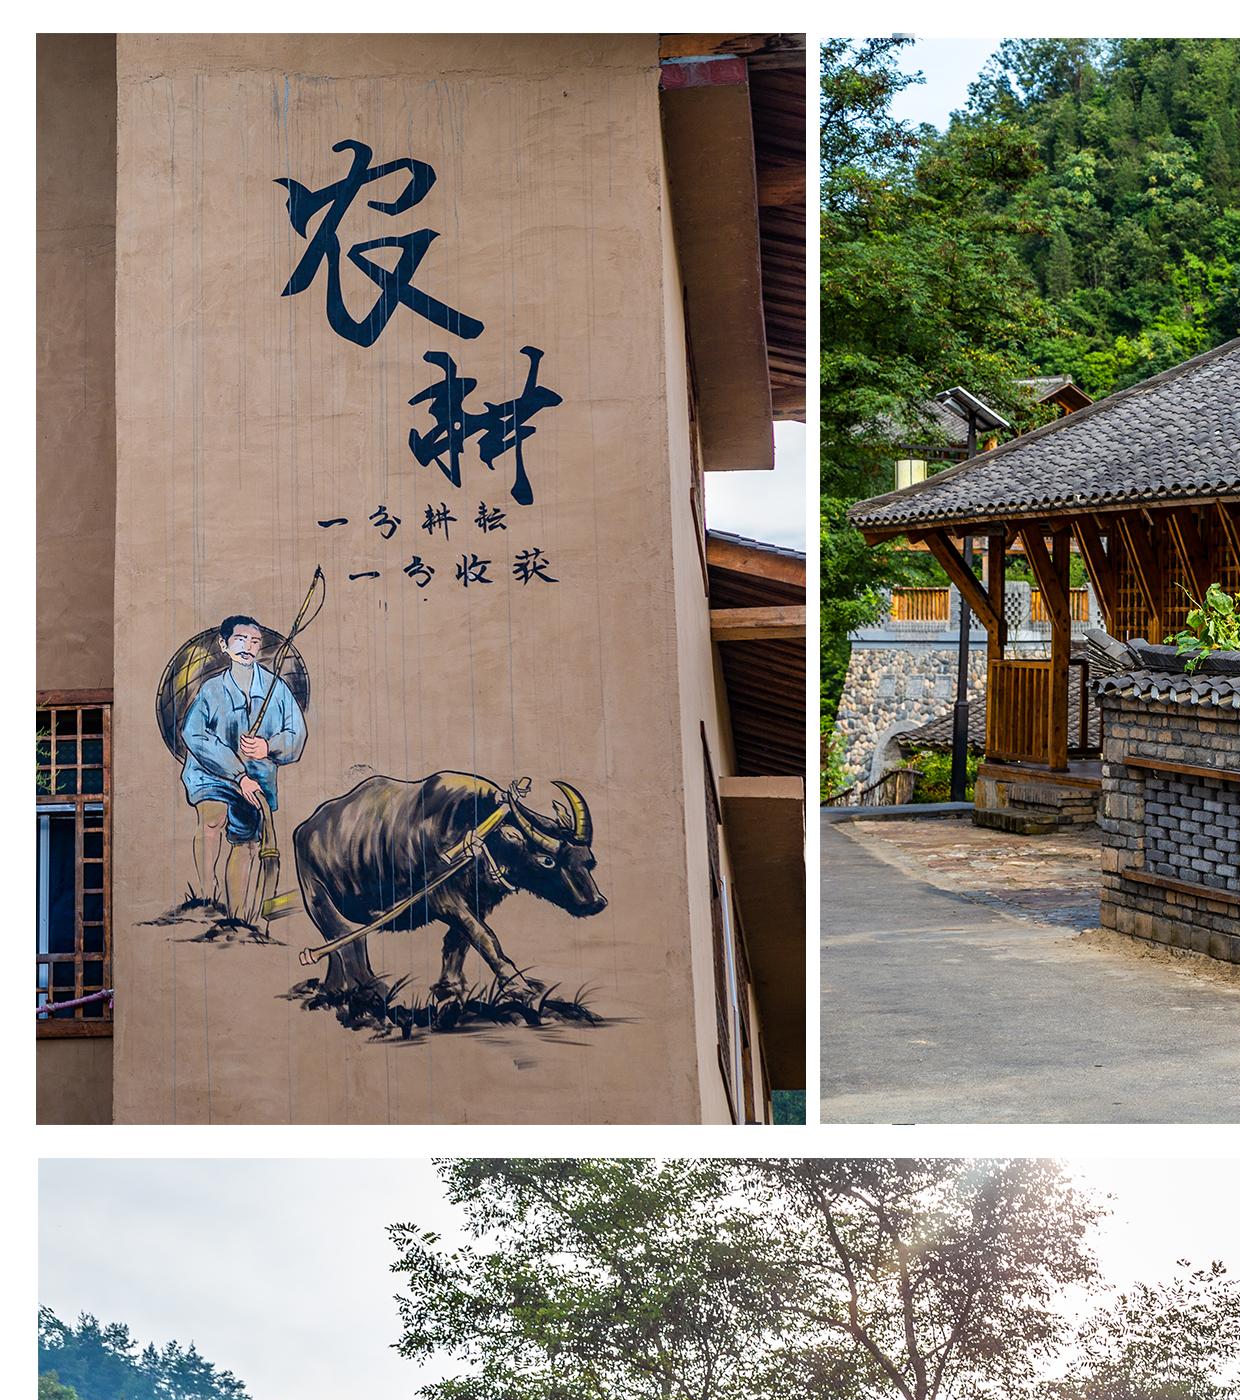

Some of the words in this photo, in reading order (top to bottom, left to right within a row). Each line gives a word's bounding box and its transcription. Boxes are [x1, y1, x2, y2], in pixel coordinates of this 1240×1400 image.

[273, 139, 563, 506] 农耕
[318, 501, 508, 541] 一分耕耘
[349, 547, 560, 588] 一分收获
